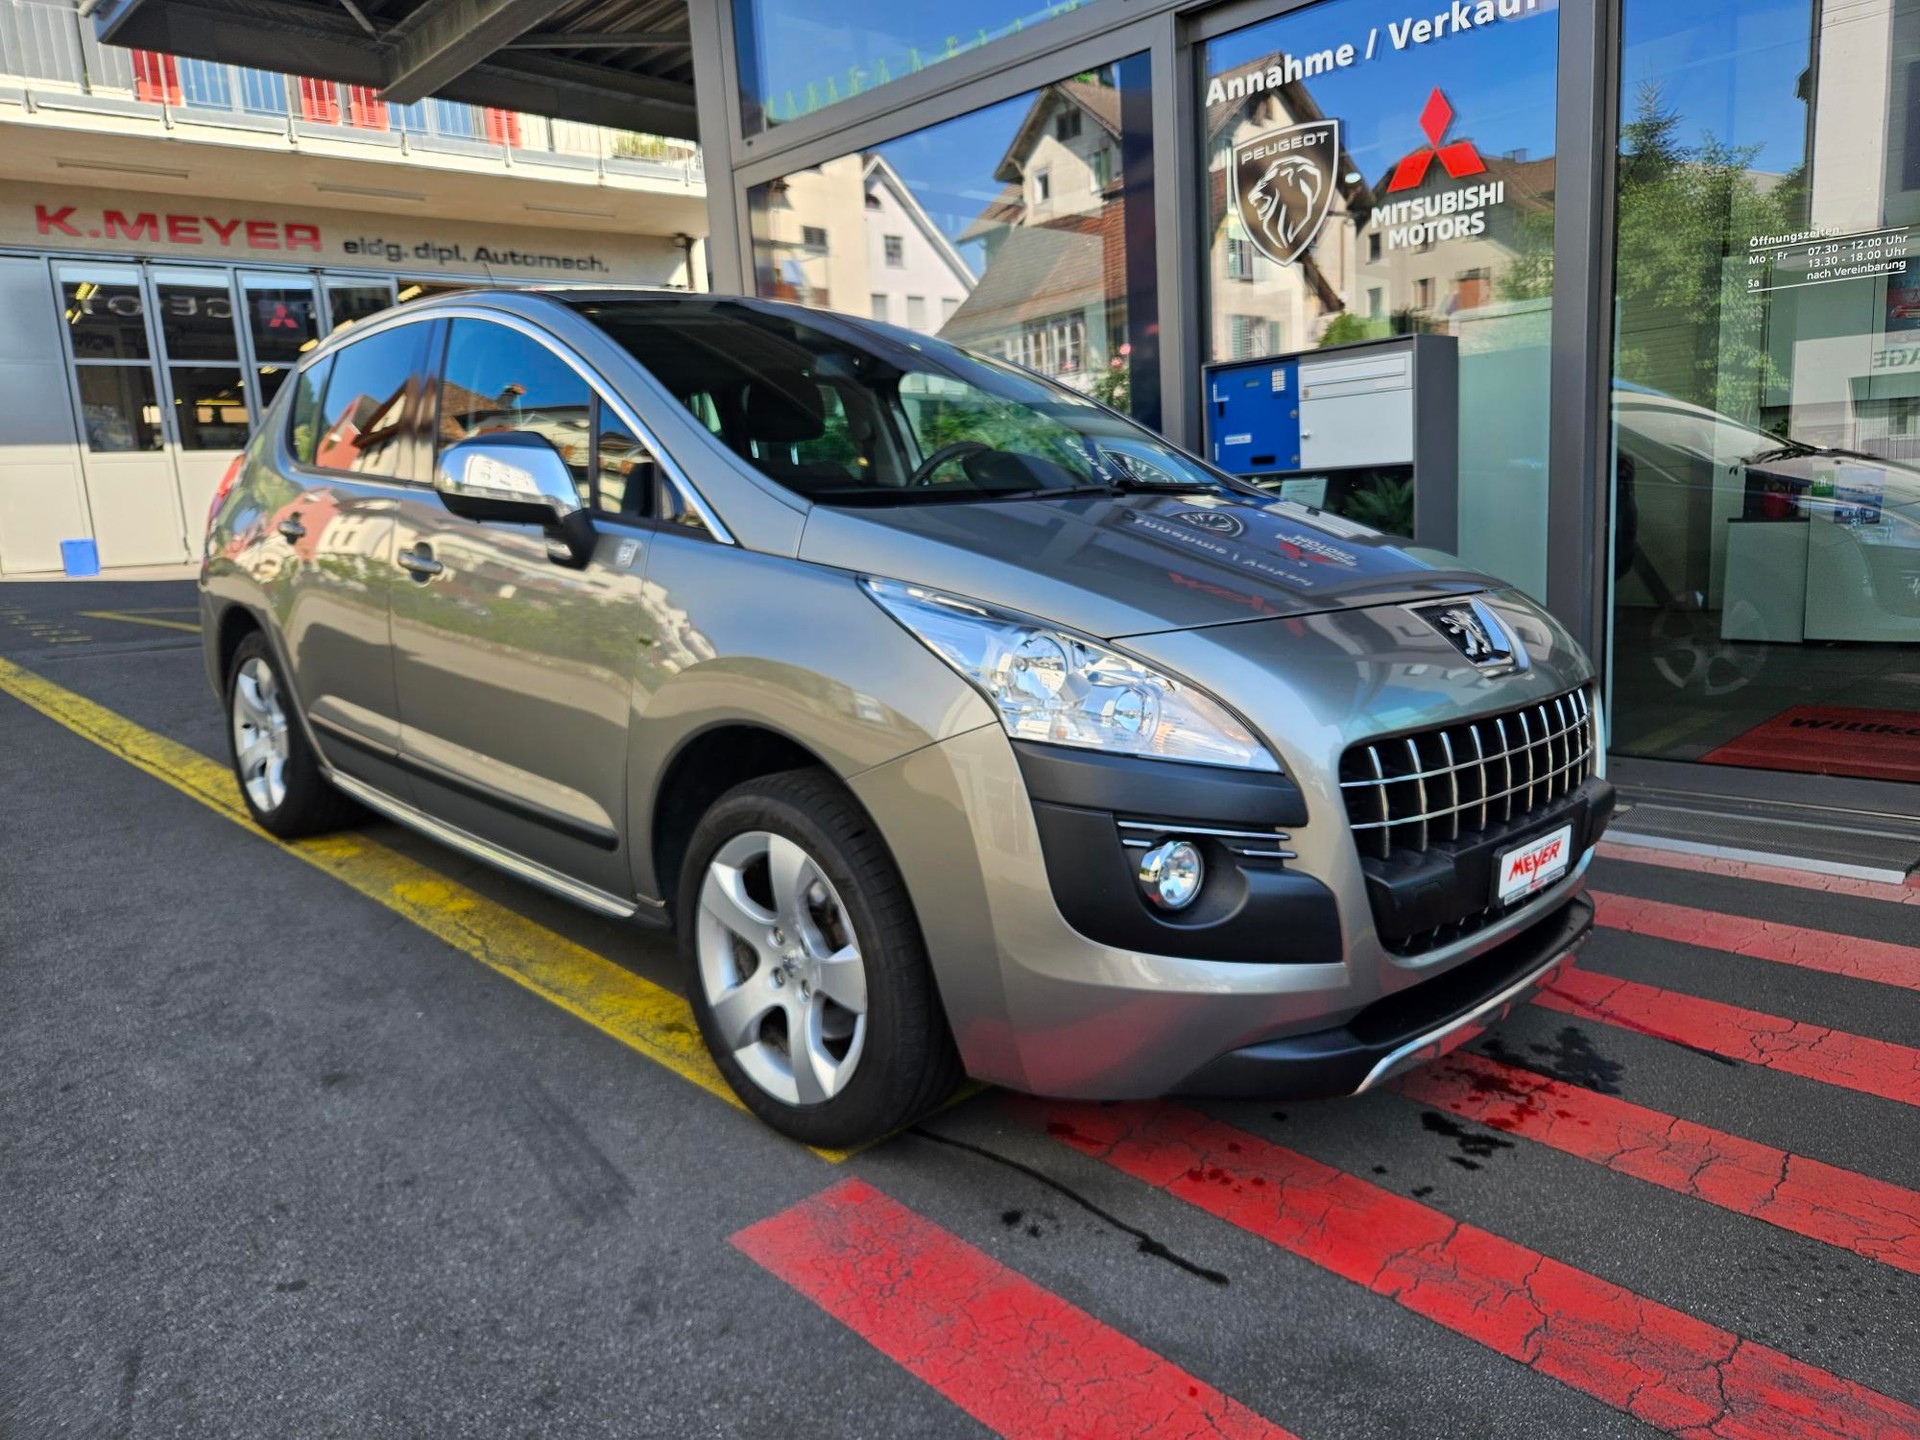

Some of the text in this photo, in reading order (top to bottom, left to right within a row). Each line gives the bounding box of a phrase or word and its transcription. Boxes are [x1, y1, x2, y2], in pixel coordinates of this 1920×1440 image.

[1205, 42, 1354, 107] Annahme
[1241, 131, 1329, 165] PEUGEOT
[1371, 181, 1504, 229] MITSUBISHI
[34, 204, 609, 273] K.MEYER eidg. dipl. Automech.
[1388, 211, 1485, 250] MOTORS
[1749, 255, 1766, 265] Mo
[1777, 251, 1788, 261] Fr
[1808, 243, 1838, 256] 07.30
[1851, 238, 1882, 250] 12.00
[1886, 233, 1908, 245] Uhr
[1748, 260, 1907, 288] Sa nach Vereinbarung
[1808, 256, 1838, 268] 13.30
[1851, 250, 1881, 262] 18.00
[1885, 246, 1907, 258] Uhr
[1508, 839, 1562, 883] MEYER
